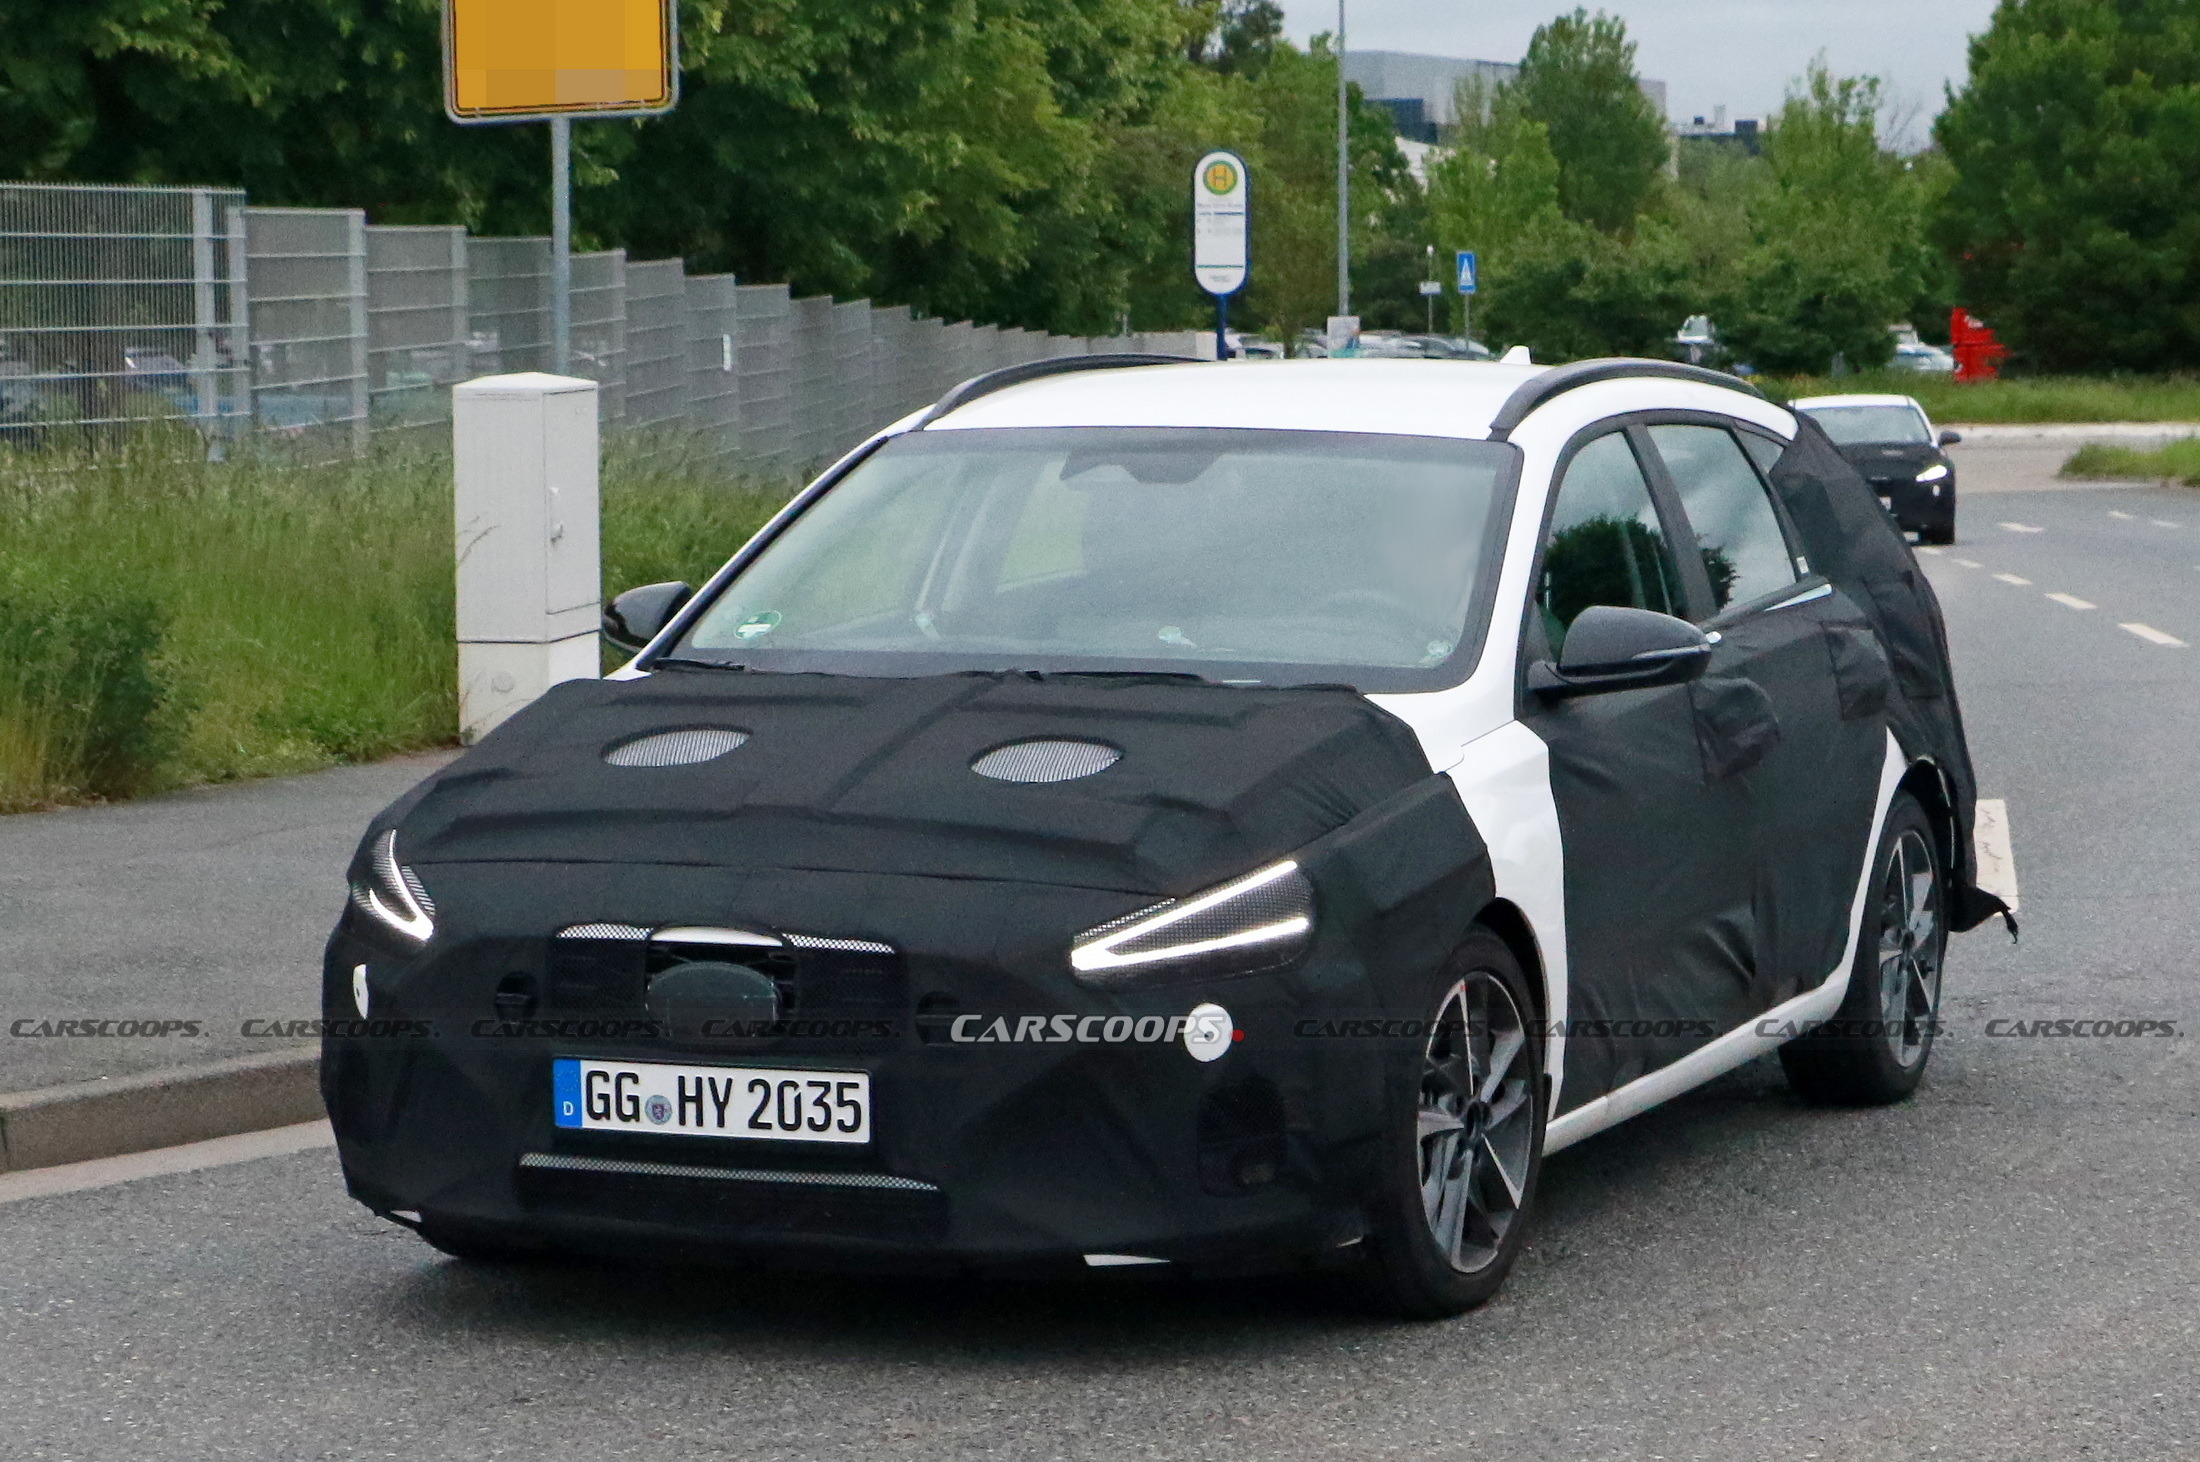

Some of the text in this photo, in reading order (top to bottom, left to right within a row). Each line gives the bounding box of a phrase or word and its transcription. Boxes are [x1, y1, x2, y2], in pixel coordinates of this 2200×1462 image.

[563, 1101, 574, 1116] D
[585, 1070, 863, 1133] GG HY 2035
